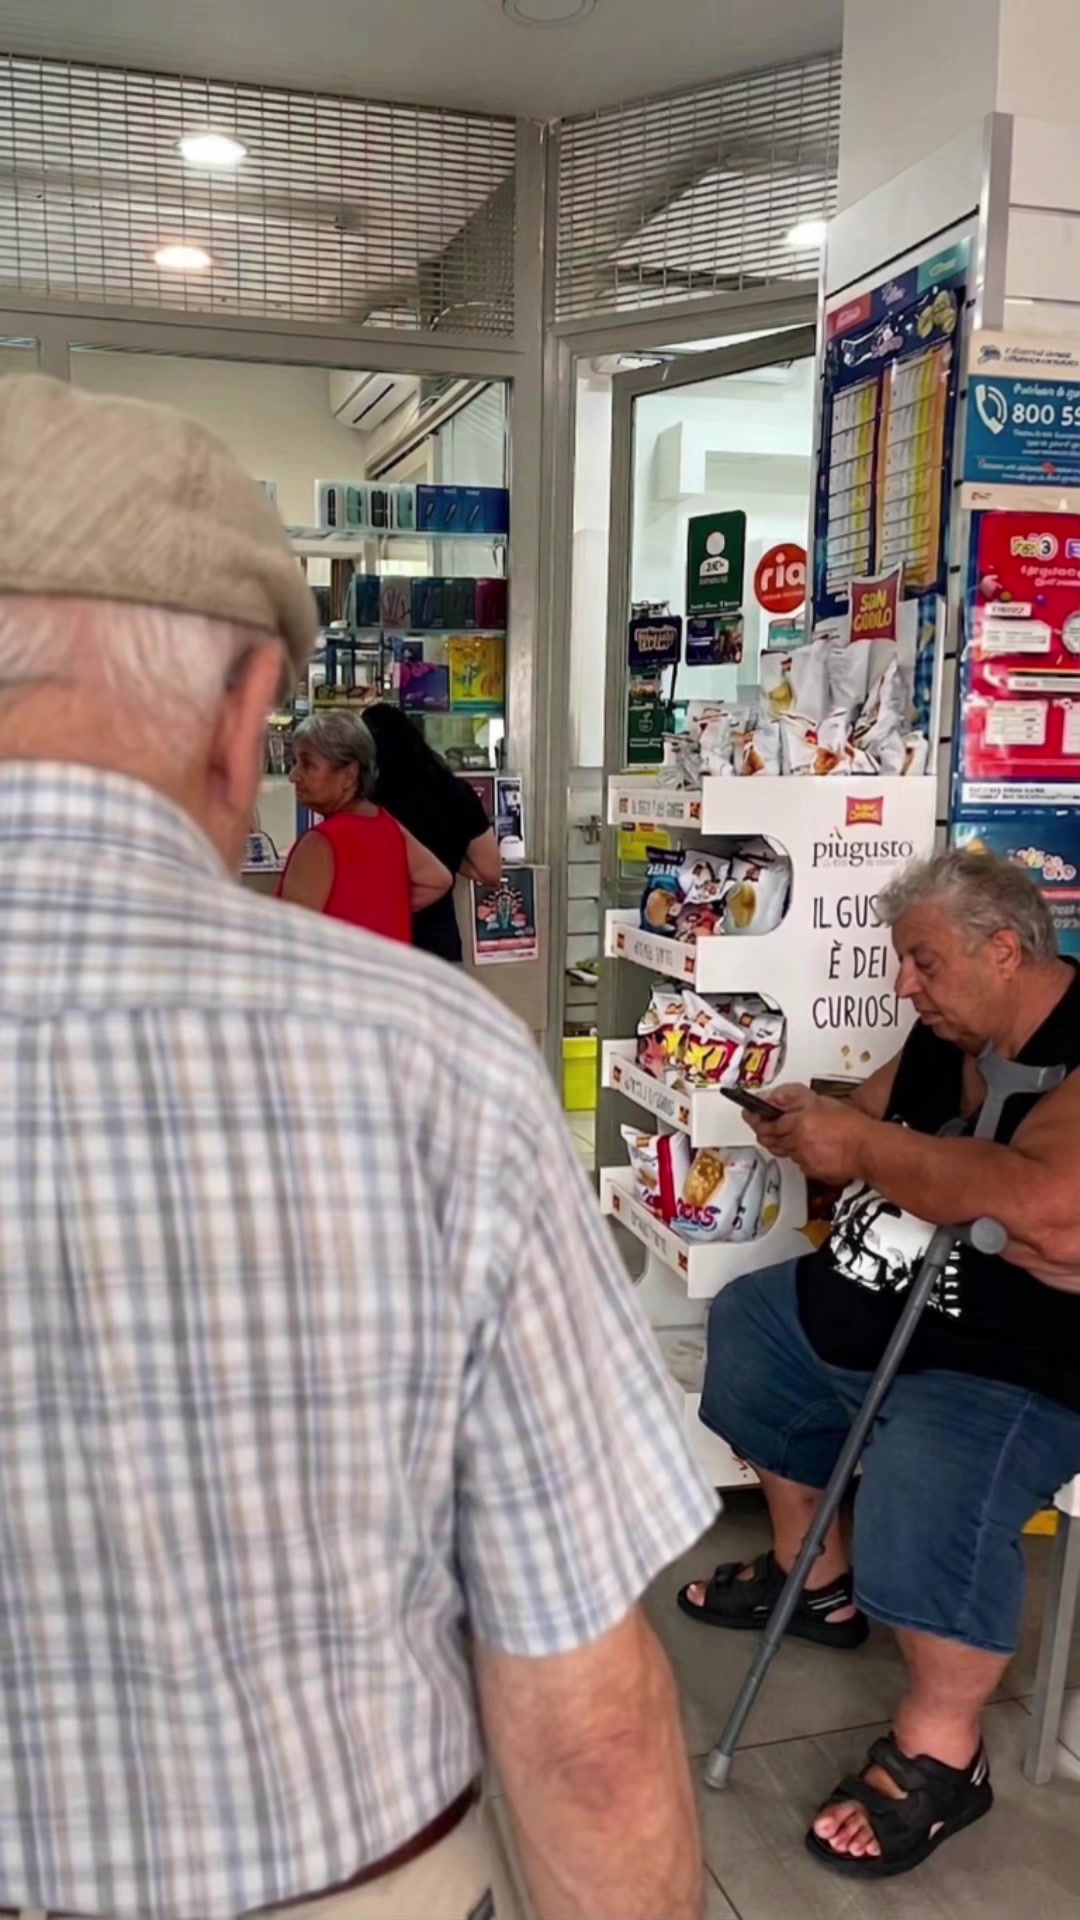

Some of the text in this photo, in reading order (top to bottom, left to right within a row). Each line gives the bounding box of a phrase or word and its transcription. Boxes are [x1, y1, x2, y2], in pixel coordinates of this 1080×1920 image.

[1011, 402, 1055, 425] 800
[760, 552, 806, 592] ria
[812, 826, 913, 868] piùgusto
[812, 894, 884, 929] IL GUS
[828, 939, 888, 980] È DEI
[812, 993, 900, 1029] CURIOSI
